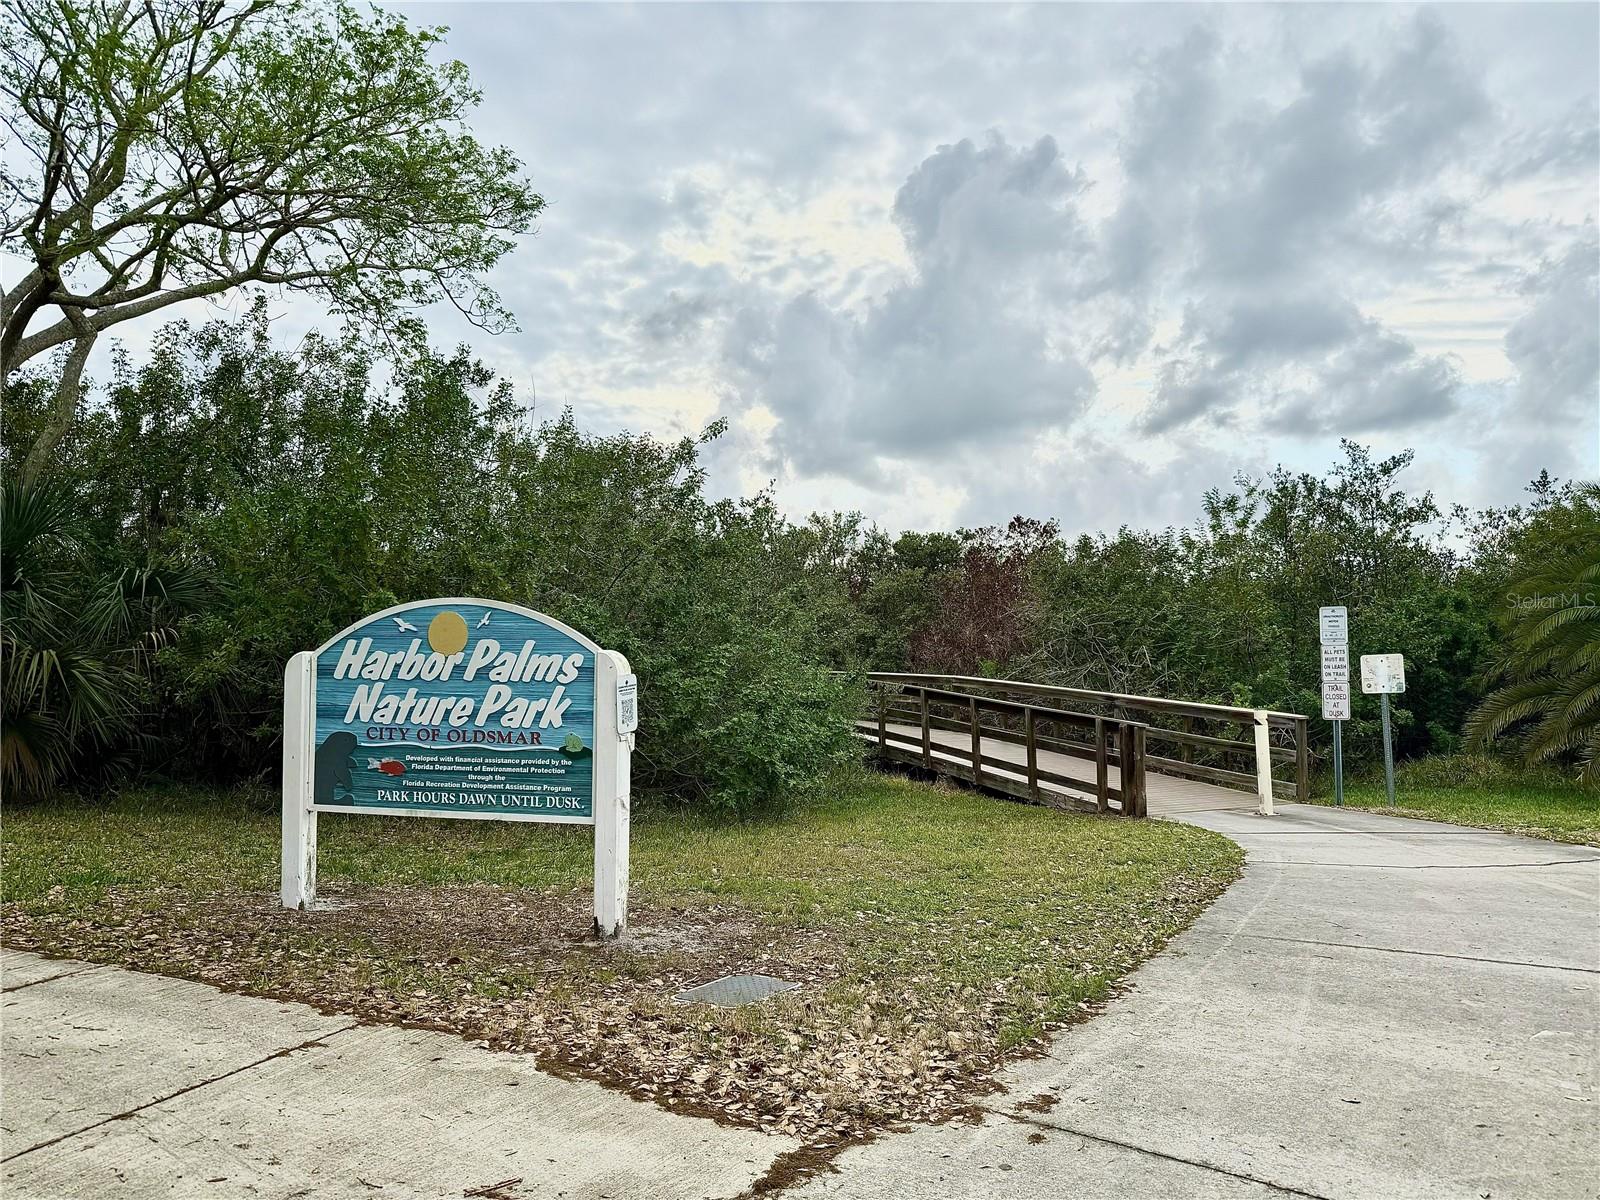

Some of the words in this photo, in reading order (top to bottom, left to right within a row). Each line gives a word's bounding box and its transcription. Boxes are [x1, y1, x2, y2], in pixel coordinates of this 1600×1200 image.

[333, 637, 465, 682] Harbor
[463, 638, 584, 684] Palms
[343, 682, 476, 727] Nature
[474, 684, 572, 728] Park
[366, 726, 410, 740] CITY
[416, 728, 440, 742] OF
[447, 729, 542, 745] OLDSMAR
[406, 755, 438, 763] Developed
[521, 758, 550, 766] provided
[552, 758, 560, 766] by
[435, 764, 472, 773] Department
[462, 782, 504, 790] Development
[543, 784, 572, 793] Program
[377, 790, 410, 802] PARK
[413, 791, 456, 804] HOURS
[459, 792, 497, 806] DAWN
[501, 794, 542, 807] UNTIL
[546, 796, 585, 809] DUSK.
